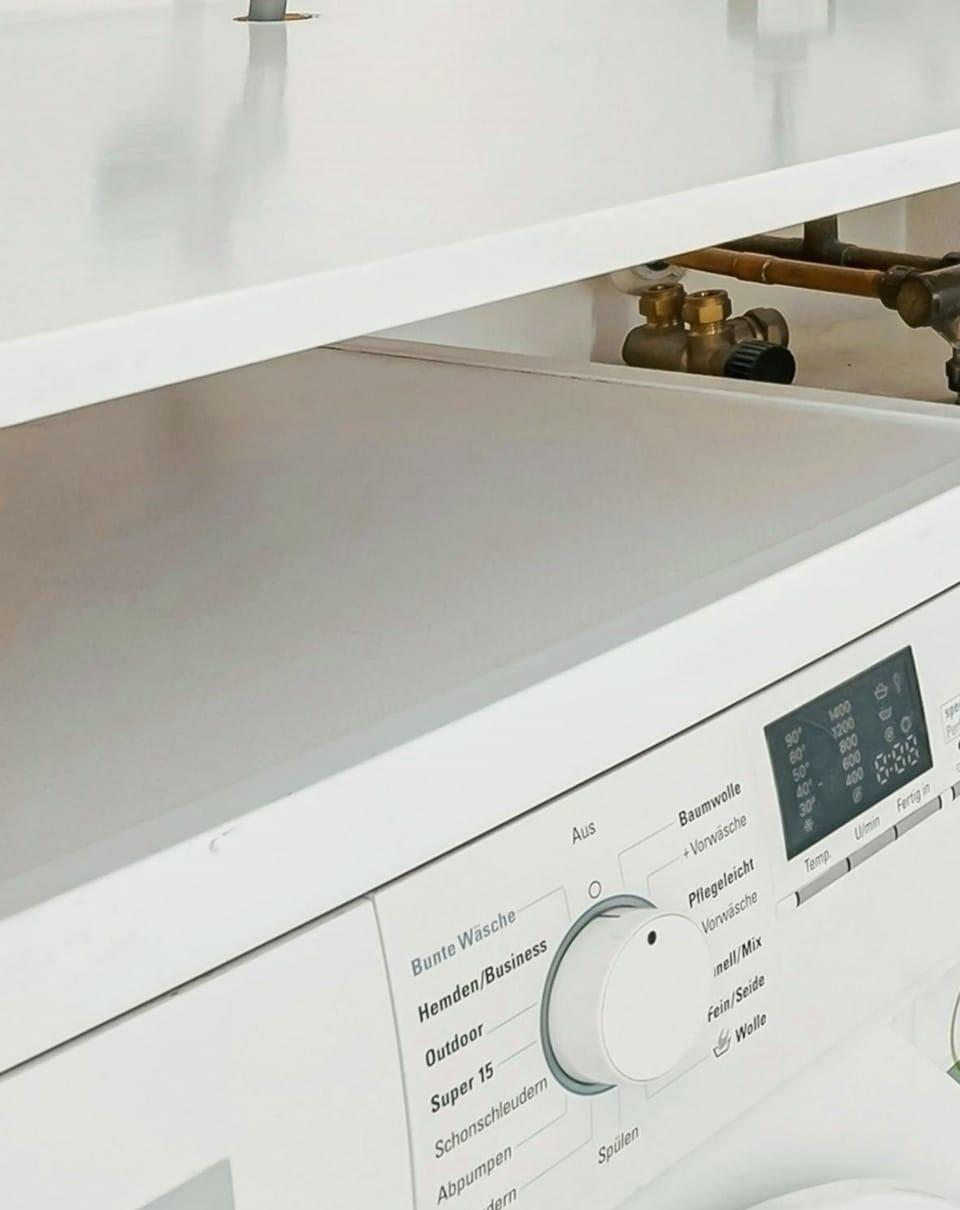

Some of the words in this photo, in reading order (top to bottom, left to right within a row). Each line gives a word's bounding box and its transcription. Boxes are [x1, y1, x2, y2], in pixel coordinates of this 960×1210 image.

[832, 716, 856, 738] 1200
[839, 733, 858, 754] 800
[845, 766, 864, 786] 400
[896, 787, 922, 812] Fertig
[922, 783, 932, 796] in
[678, 780, 742, 828] Baumwolle
[572, 820, 597, 845] Aus
[689, 812, 748, 857] Vorwäsche
[853, 815, 882, 841] U/min
[803, 847, 832, 874] Temp.
[687, 857, 755, 908] Pflegeleicht
[701, 889, 759, 935] Vorwäsche
[410, 942, 457, 977] Bunte
[457, 909, 516, 950] Wäsche
[713, 936, 763, 978] nell/Mix
[418, 938, 548, 1023] Hemden/Business
[425, 1023, 484, 1067] Outdoor
[734, 1012, 767, 1044] Wolle
[430, 1076, 474, 1113] Super
[478, 1061, 495, 1083] 15
[434, 1076, 548, 1159] Schonschleudern
[597, 1125, 640, 1166] Spülen
[436, 1144, 513, 1206] Abpumpen
